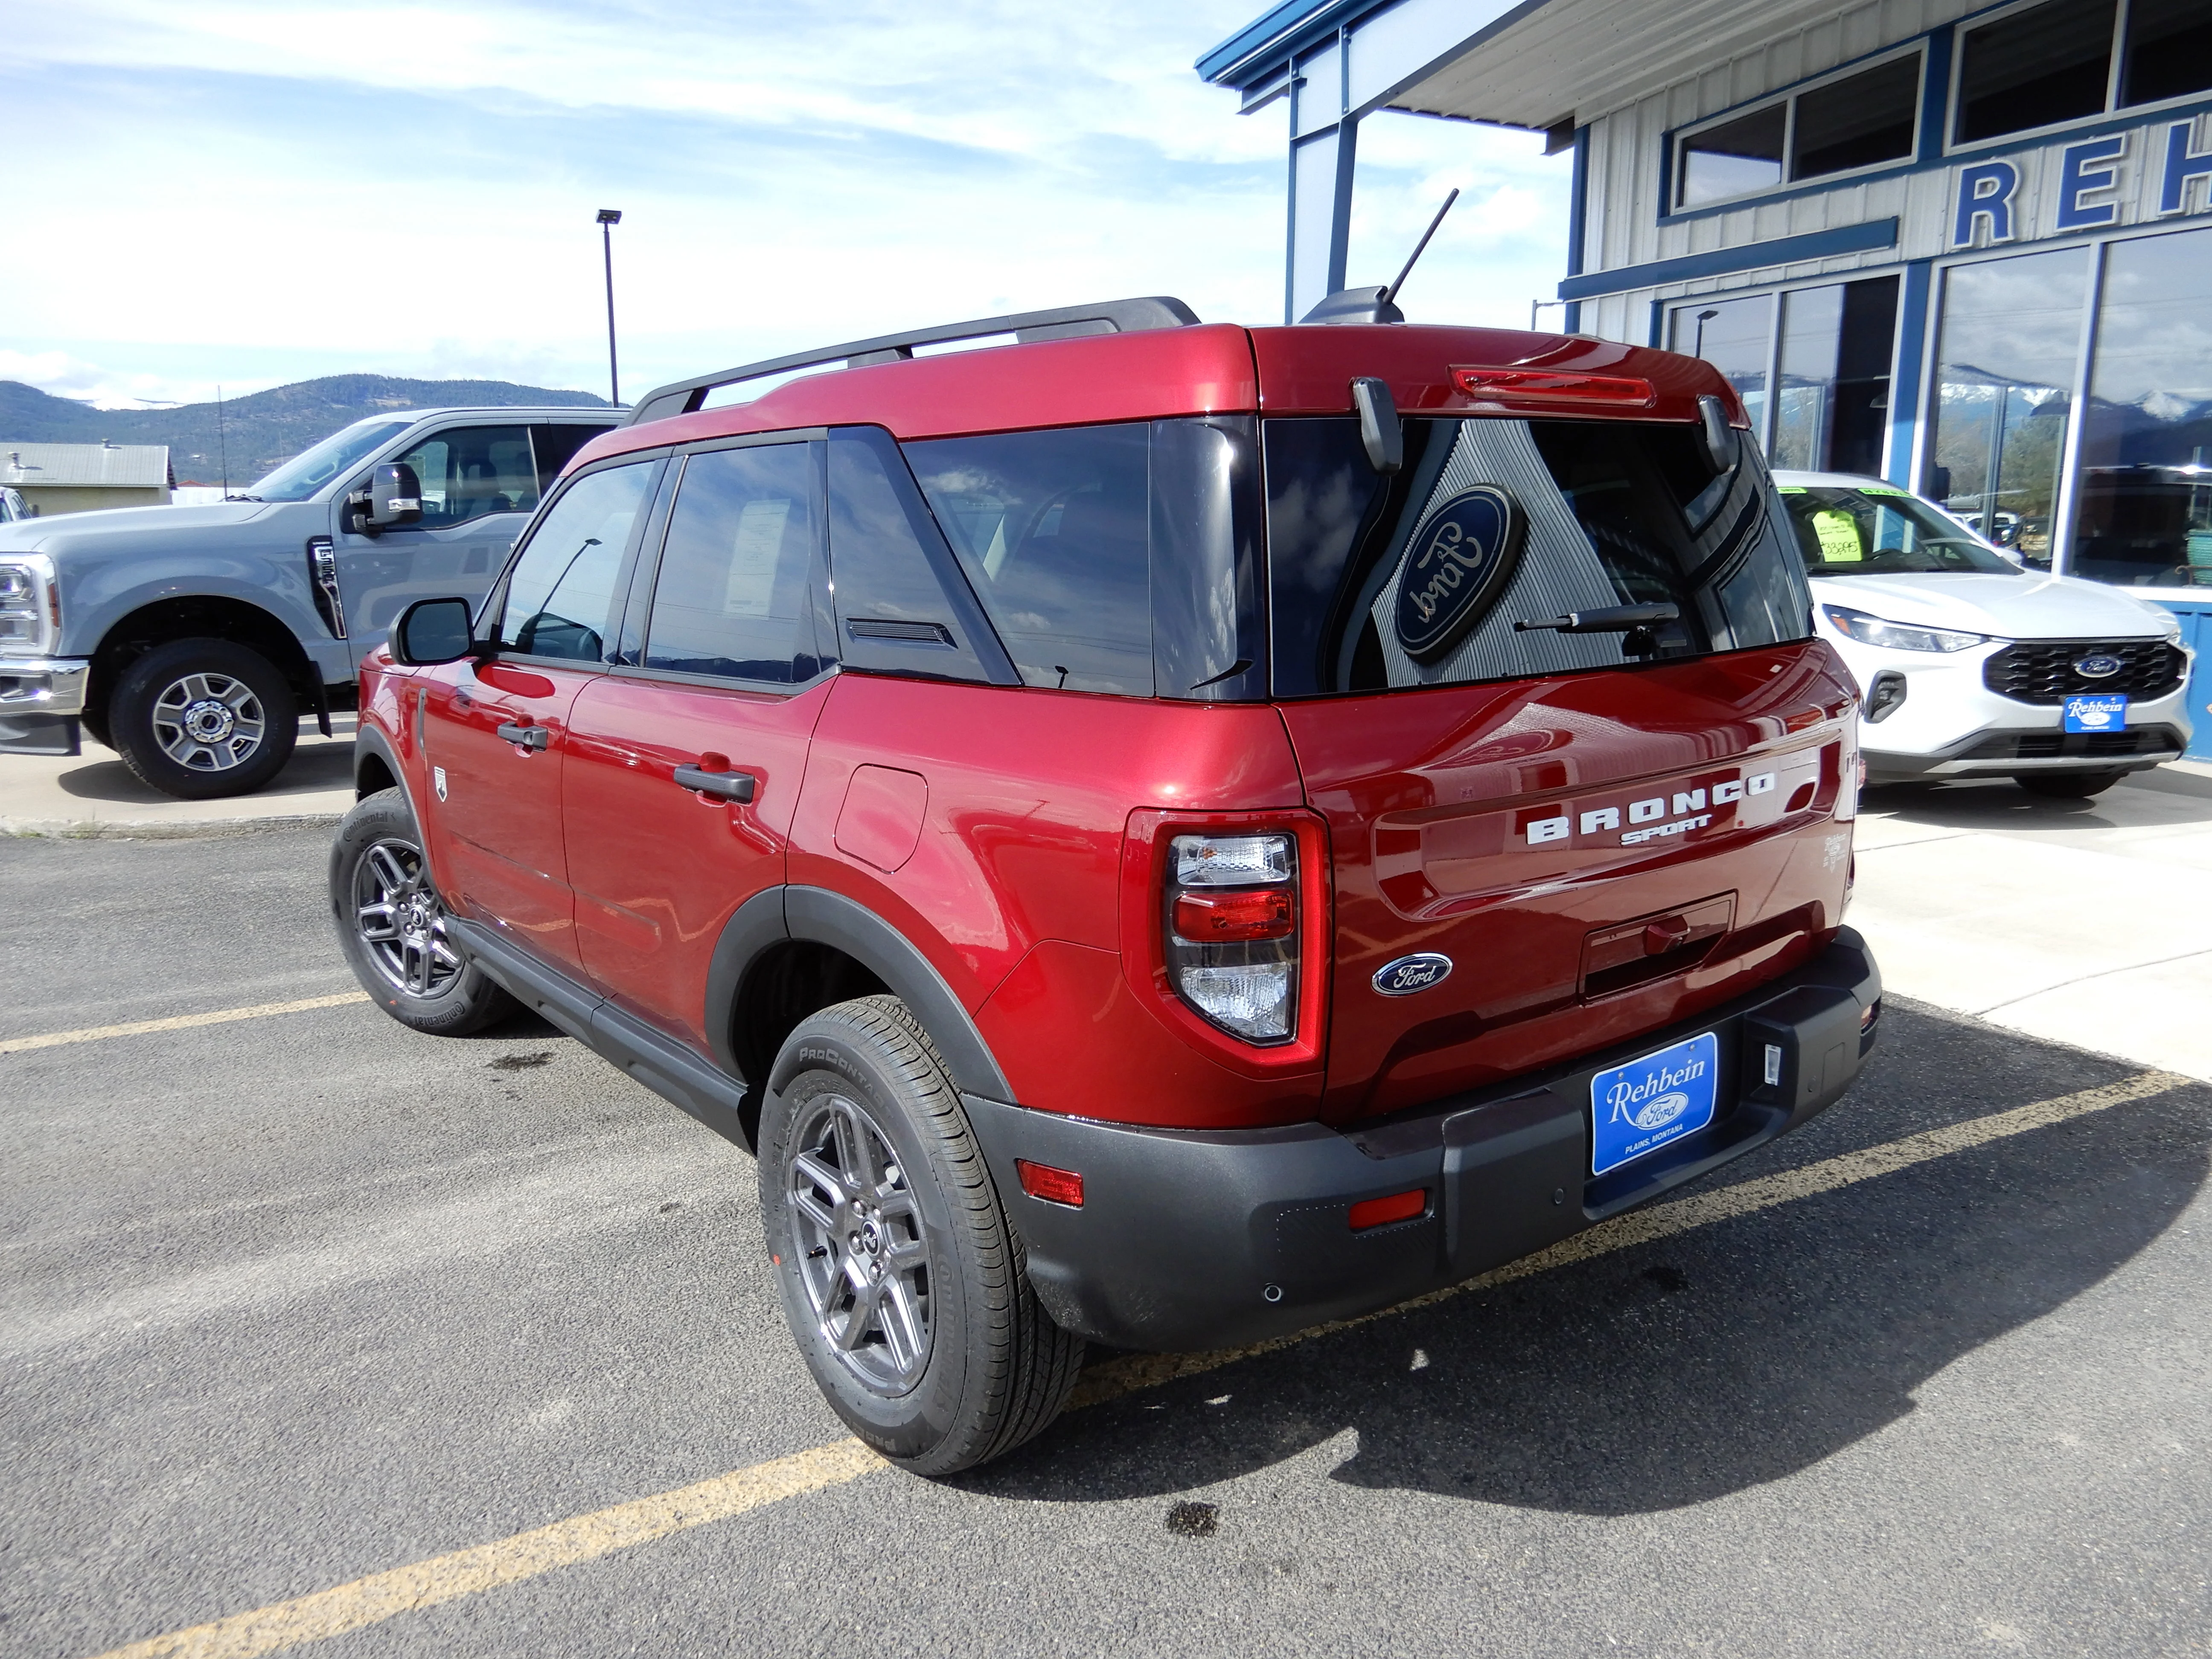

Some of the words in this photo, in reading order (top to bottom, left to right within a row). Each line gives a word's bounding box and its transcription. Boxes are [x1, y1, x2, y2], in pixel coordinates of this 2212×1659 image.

[2086, 660, 2113, 672] Ford
[2068, 701, 2123, 719] Rehbein
[1527, 772, 1775, 845] BRONCO
[1621, 814, 1712, 846] SPORT
[1393, 962, 1438, 988] Ford
[1607, 1059, 1706, 1127] Rehbein
[1644, 1098, 1678, 1126] Ford
[1624, 1137, 1650, 1155] PLAINS,
[1652, 1123, 1683, 1143] MONTANA
